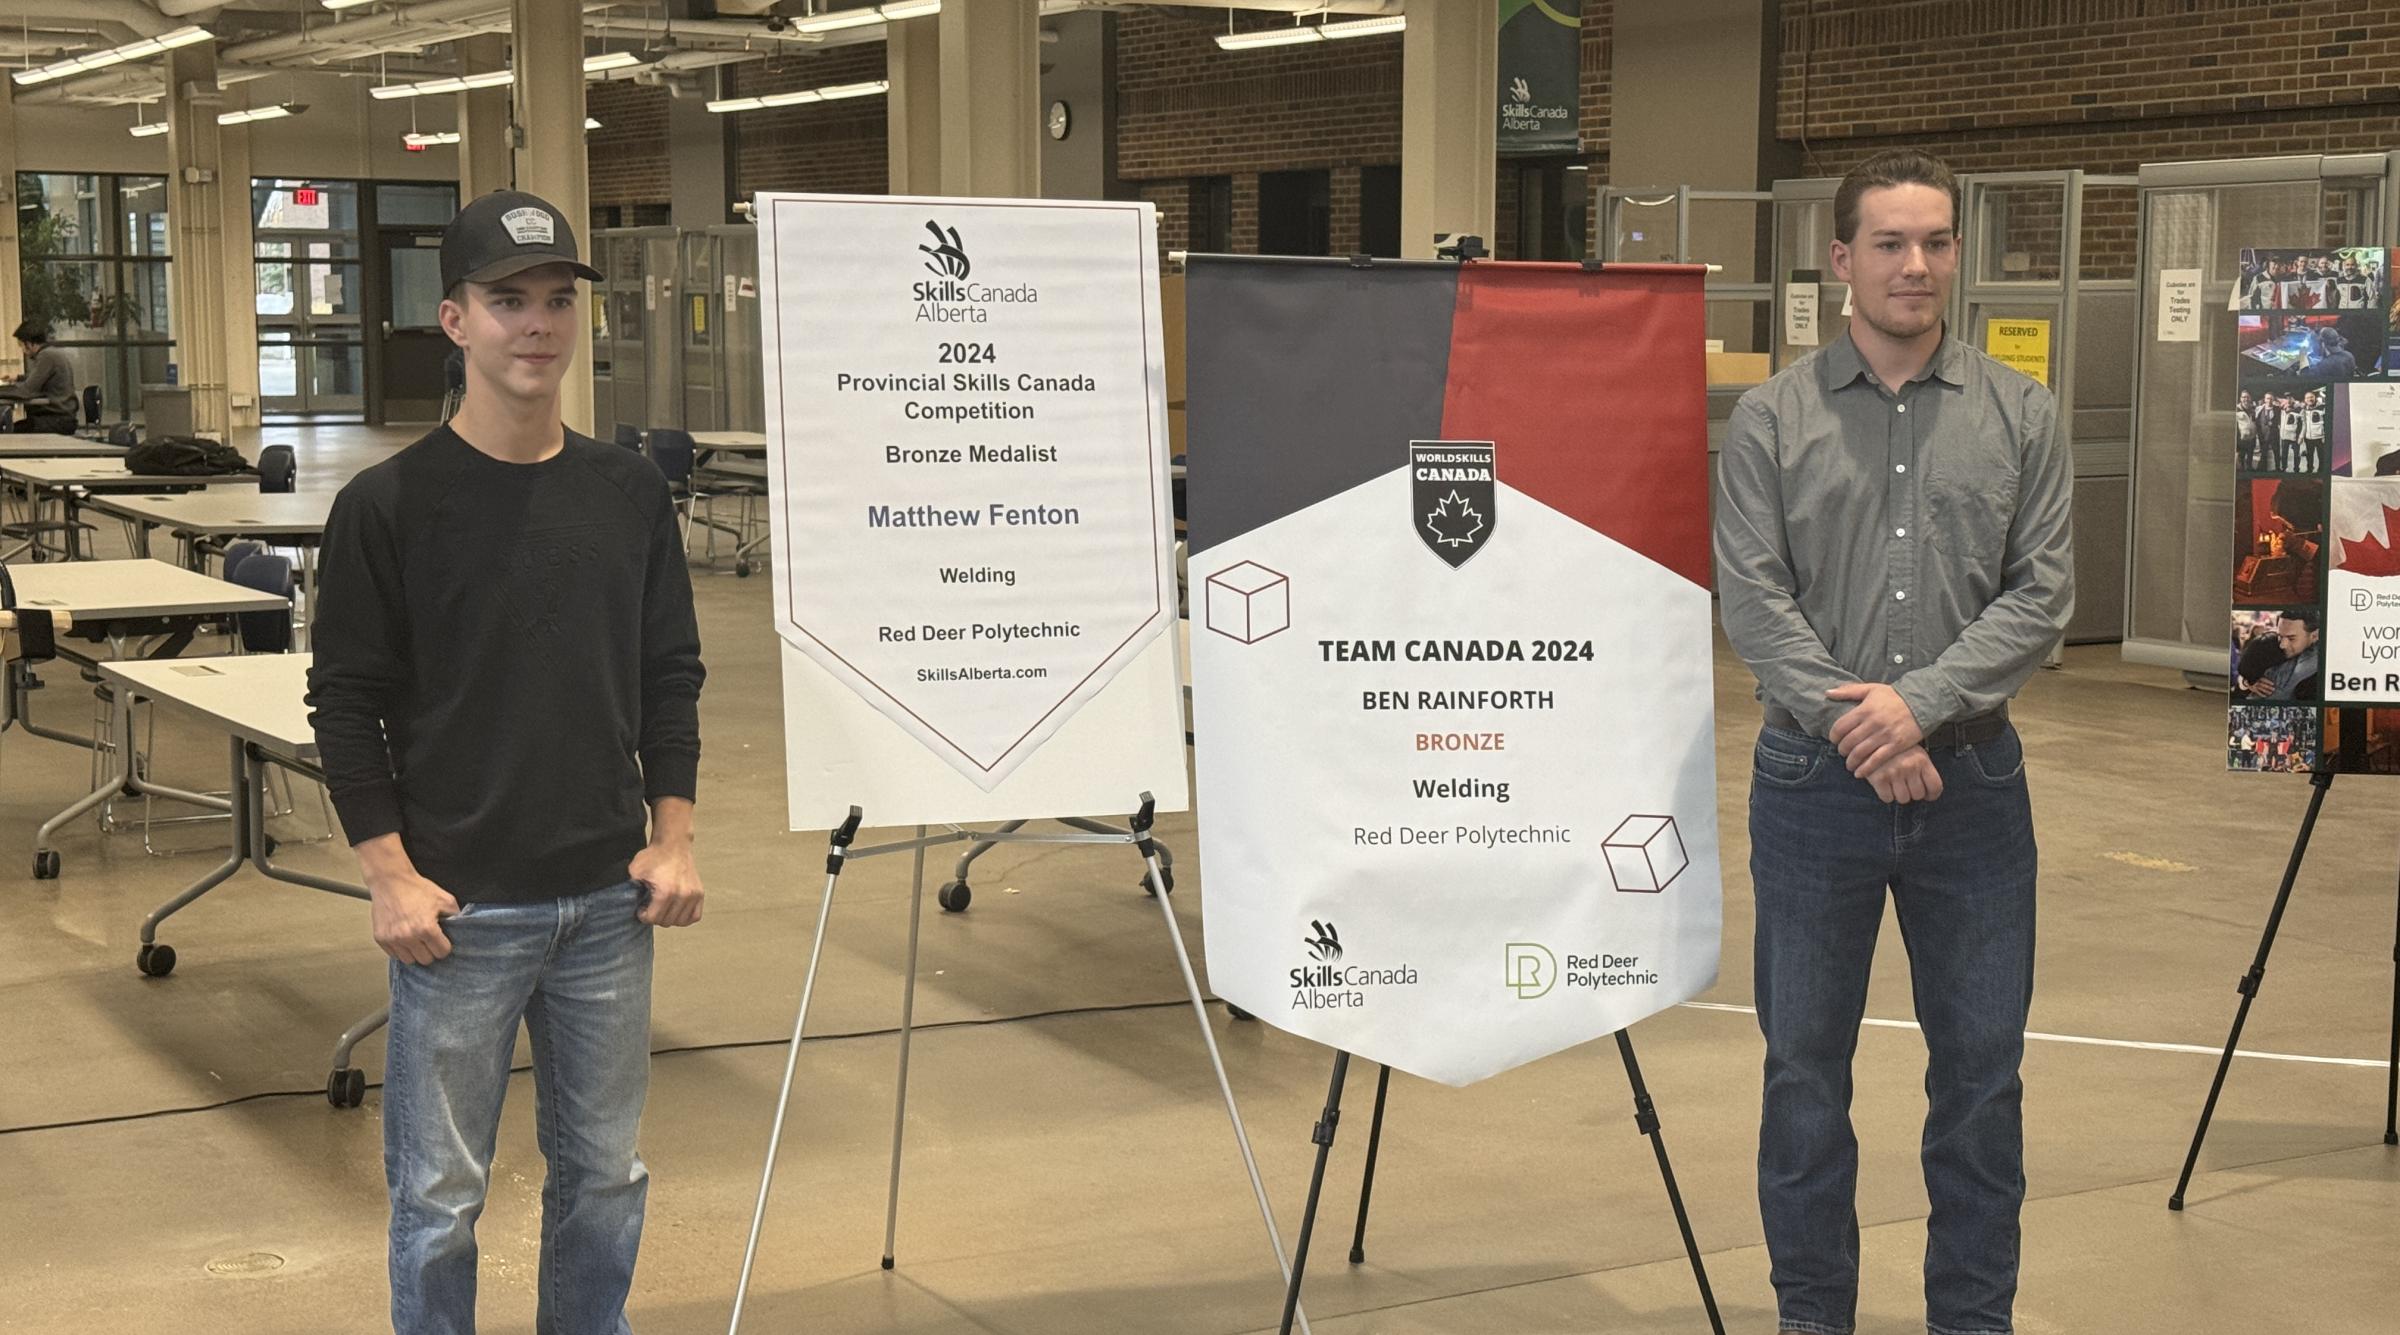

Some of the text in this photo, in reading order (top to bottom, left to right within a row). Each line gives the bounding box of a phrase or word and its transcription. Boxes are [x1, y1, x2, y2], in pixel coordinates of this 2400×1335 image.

[1502, 118, 1540, 130] Alberta
[298, 190, 315, 204] EXIT
[2170, 296, 2190, 304] Trades
[915, 303, 988, 324] Alberta
[2169, 306, 2191, 315] Testing
[2171, 315, 2188, 323] ONLY
[1999, 326, 2039, 337] RESERVED
[938, 342, 997, 364] 2024
[2016, 354, 2046, 363] STUDENTS
[837, 372, 1096, 392] Provincial Skills Canada
[904, 400, 1035, 425] Competition
[885, 444, 1058, 464] Bronze Medalist
[1415, 453, 1491, 463] WORLDSKILLS
[1415, 468, 1492, 481] CANADA
[868, 504, 1080, 528] Matthew Fenton
[939, 567, 1016, 586] Welding
[878, 621, 1081, 643] Red Deer Polytechnic
[1318, 640, 1595, 662] TEAM CANADA 2024
[916, 666, 1048, 682] SkillsAlberta.com
[2331, 672, 2377, 691] Ben
[1362, 690, 1554, 710] BEN RAINFORTH
[1415, 732, 1505, 751] BRONZE
[1412, 778, 1511, 803] Welding
[1354, 824, 1571, 849] Red Deer Polytechnic
[1566, 953, 1639, 970] Red Deer
[1566, 969, 1659, 991] Polytechnic
[1290, 986, 1364, 1010] Alberta
